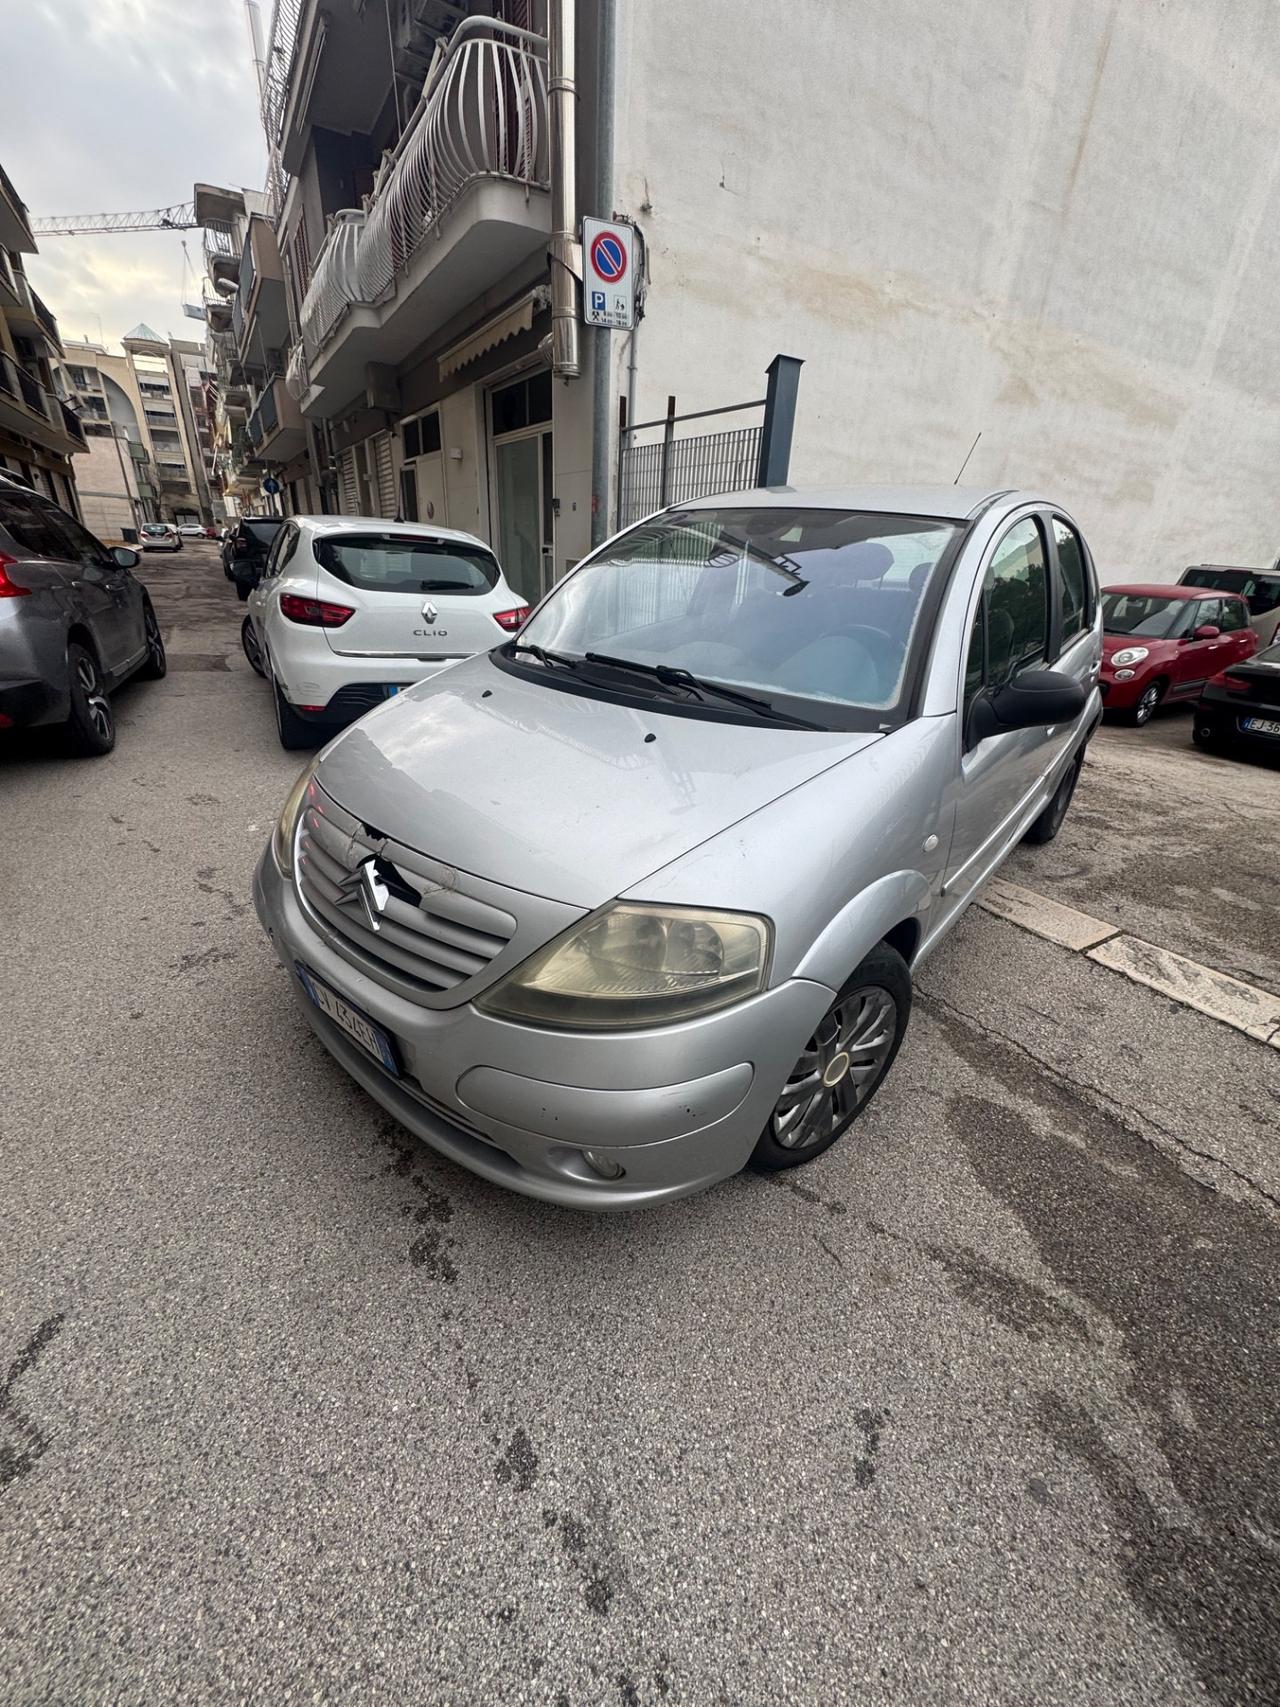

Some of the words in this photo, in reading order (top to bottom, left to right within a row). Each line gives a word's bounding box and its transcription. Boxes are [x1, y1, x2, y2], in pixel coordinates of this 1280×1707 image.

[594, 293, 604, 309] P
[413, 629, 448, 637] CLIO
[1250, 719, 1265, 730] EJ
